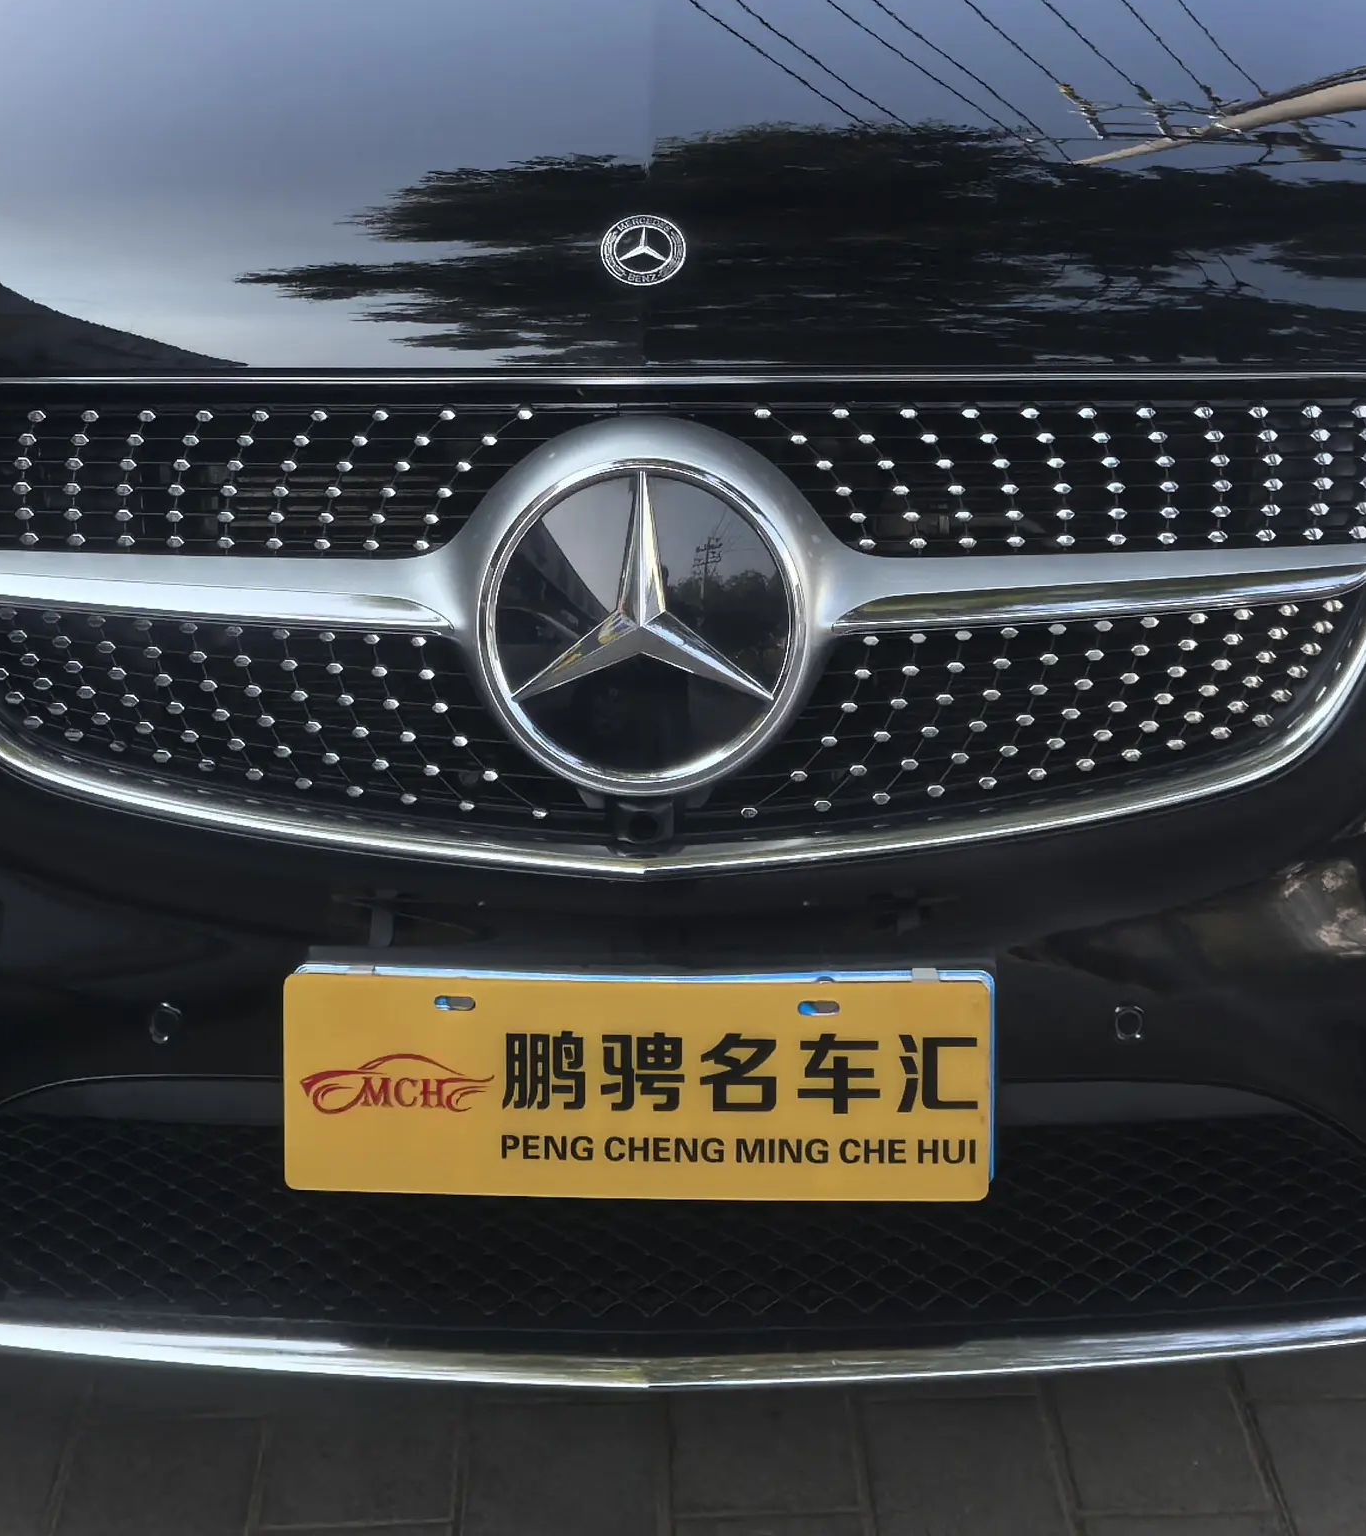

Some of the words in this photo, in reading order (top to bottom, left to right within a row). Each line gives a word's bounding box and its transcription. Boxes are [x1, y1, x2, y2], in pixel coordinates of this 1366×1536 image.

[627, 273, 659, 283] BENZ
[501, 1030, 979, 1114] 鹏骋名车汇
[500, 1134, 594, 1162] PENG
[603, 1136, 725, 1164] CHENG
[736, 1137, 830, 1165] MING
[838, 1138, 906, 1165] CHE
[916, 1138, 977, 1165] HUI
